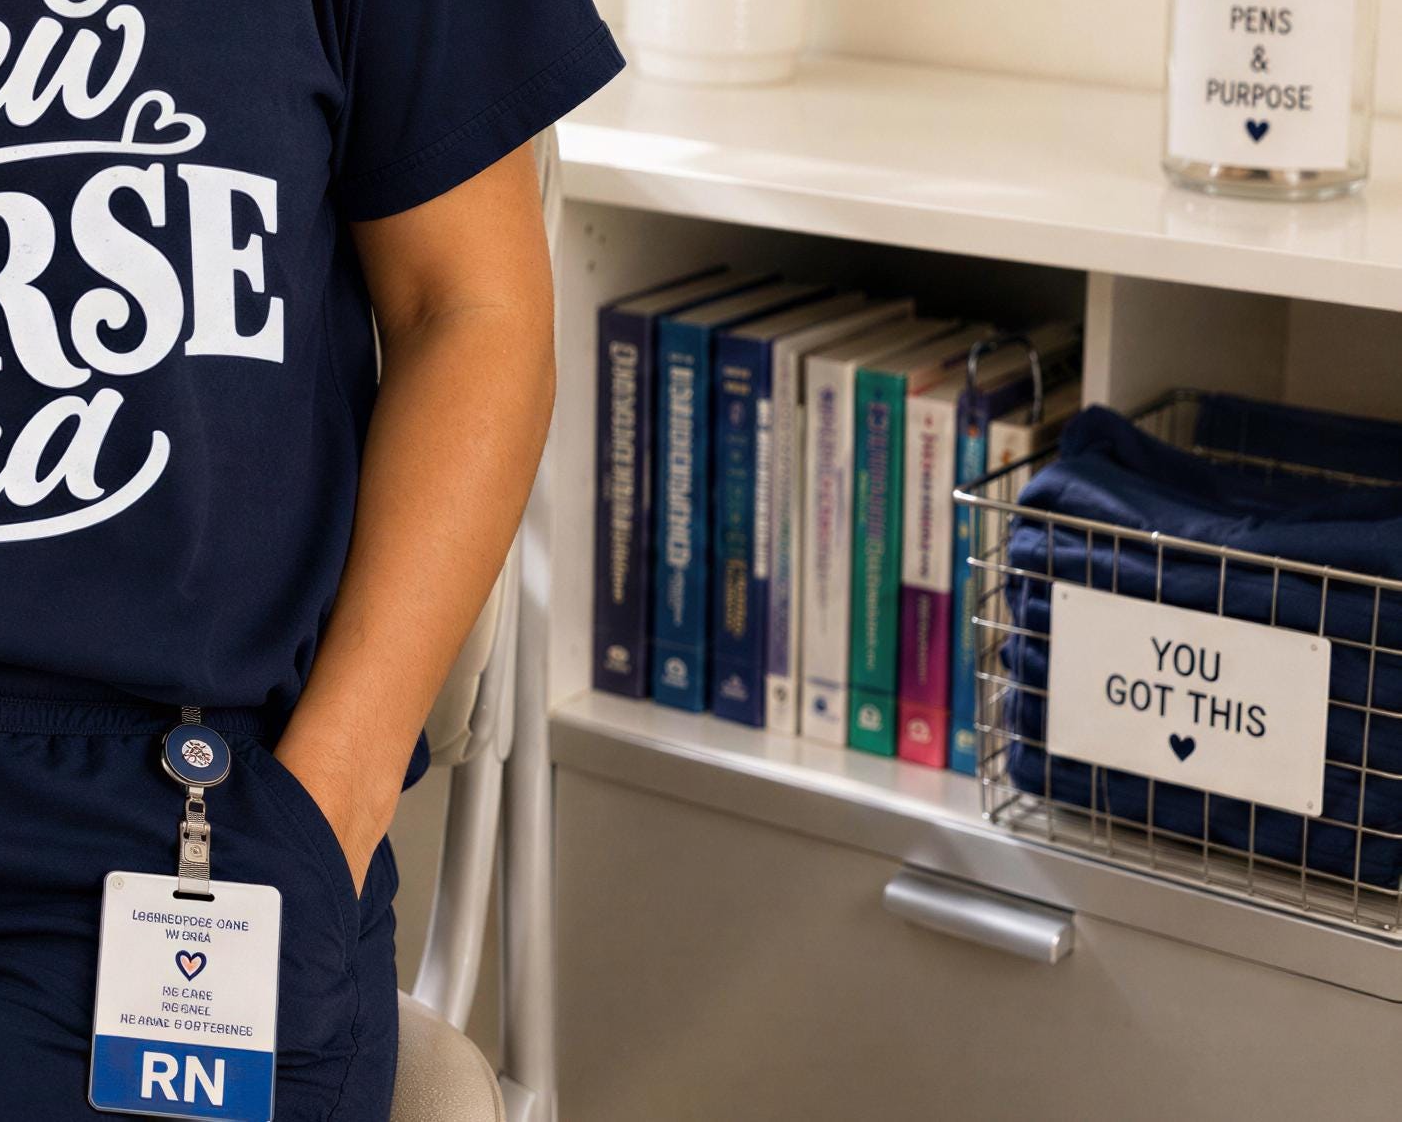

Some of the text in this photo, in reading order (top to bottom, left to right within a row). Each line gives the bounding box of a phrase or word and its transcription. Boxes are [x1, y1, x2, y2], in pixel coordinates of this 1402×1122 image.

[1231, 6, 1292, 35] PENS
[1250, 45, 1267, 72] &
[1206, 79, 1310, 111] PURPOSE
[1151, 638, 1221, 683] YOU
[1106, 674, 1267, 738] GOT THIS
[140, 1051, 226, 1107] RN
